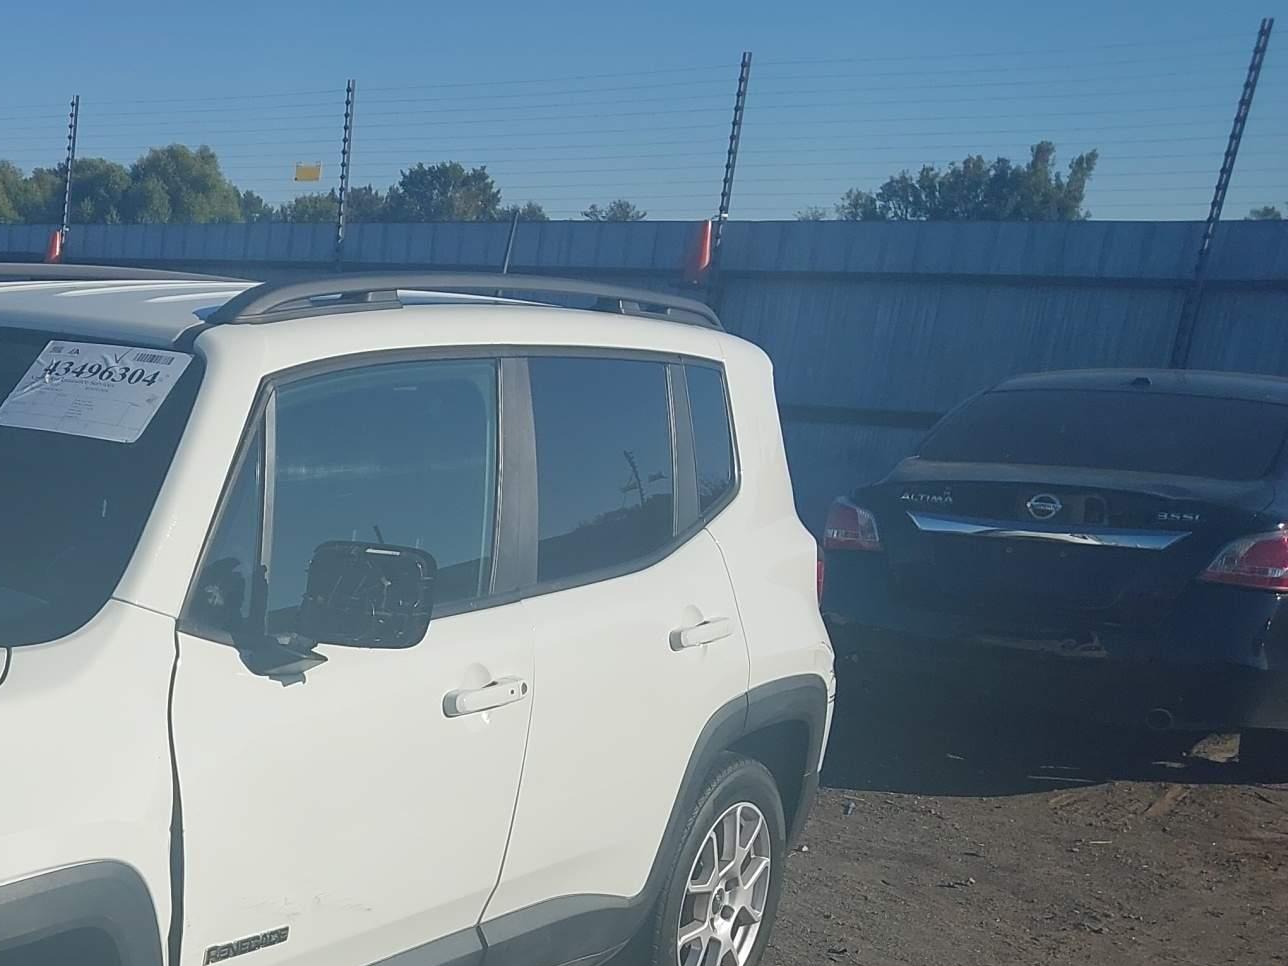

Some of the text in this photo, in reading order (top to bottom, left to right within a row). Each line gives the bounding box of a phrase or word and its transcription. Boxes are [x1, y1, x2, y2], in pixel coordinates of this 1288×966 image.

[43, 360, 161, 387] 43496304
[900, 492, 953, 504] ALTIMA
[202, 926, 290, 966] RENEGADE
